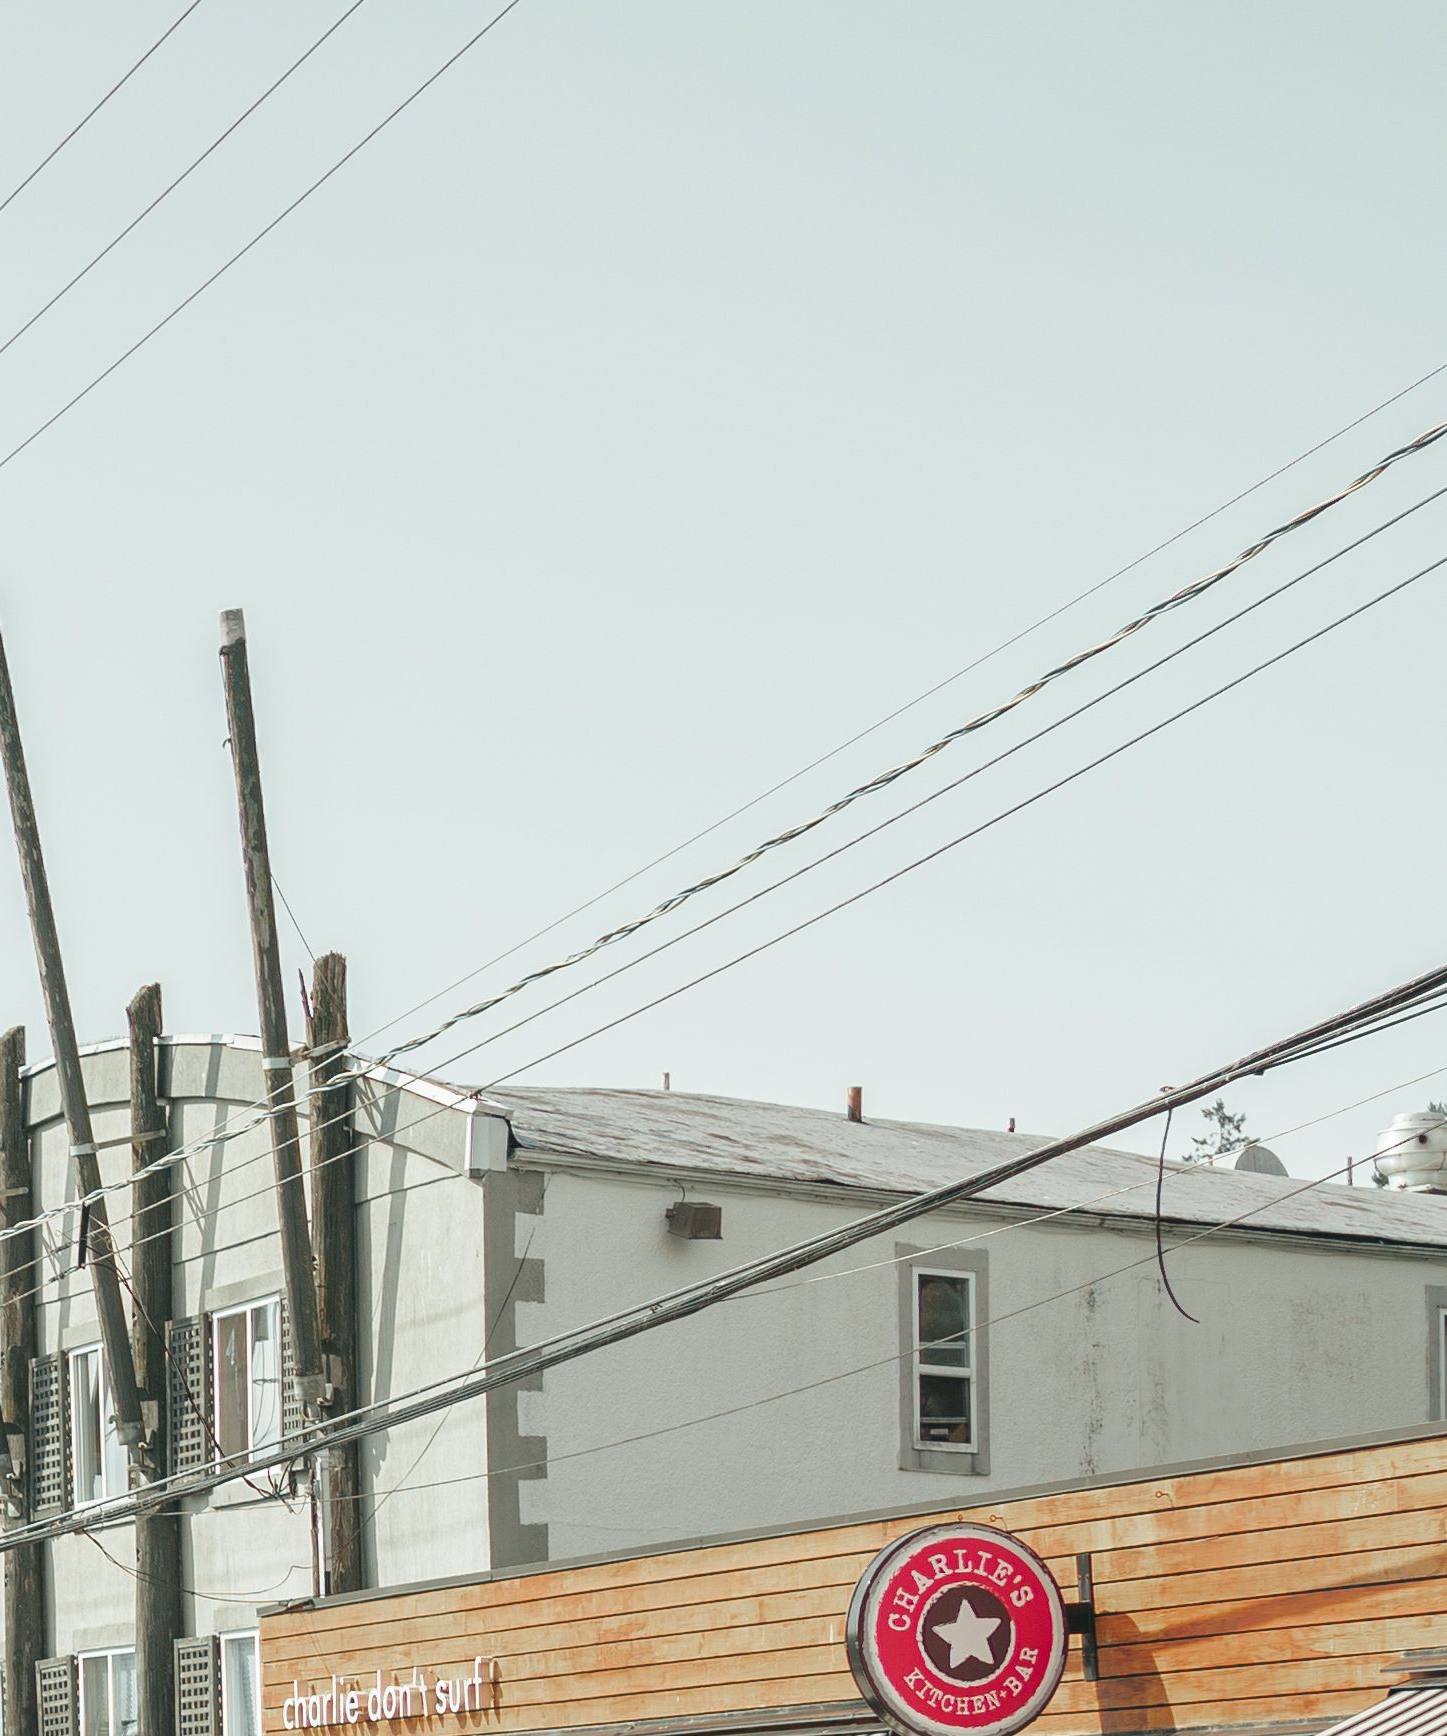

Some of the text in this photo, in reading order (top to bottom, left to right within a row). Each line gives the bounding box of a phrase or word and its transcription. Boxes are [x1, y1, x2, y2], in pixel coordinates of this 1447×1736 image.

[887, 1549, 1034, 1631] CHARLIE'S
[282, 1655, 485, 1730] charlie don't surf
